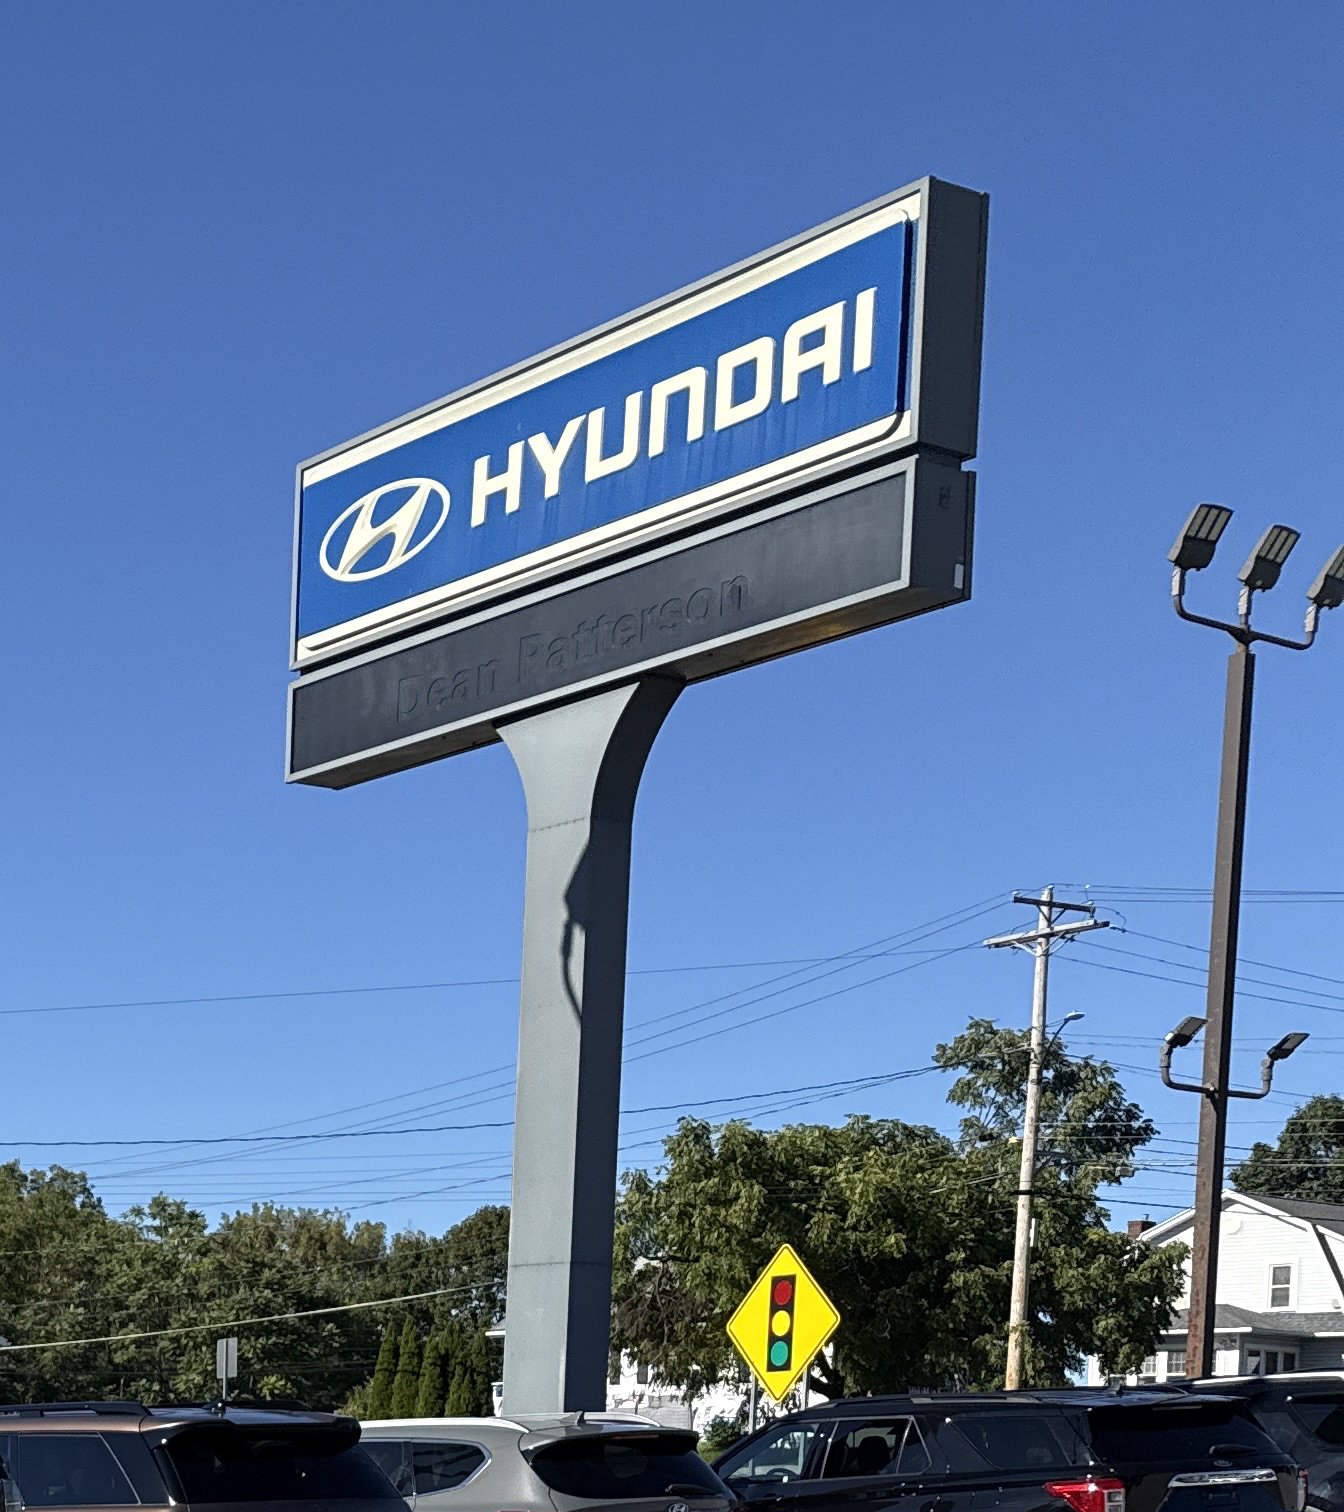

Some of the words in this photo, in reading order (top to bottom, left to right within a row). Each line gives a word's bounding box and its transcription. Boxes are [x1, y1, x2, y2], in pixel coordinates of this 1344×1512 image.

[470, 286, 878, 529] HYUNDAI
[396, 658, 500, 722] Dean
[517, 573, 750, 682] Patterson
